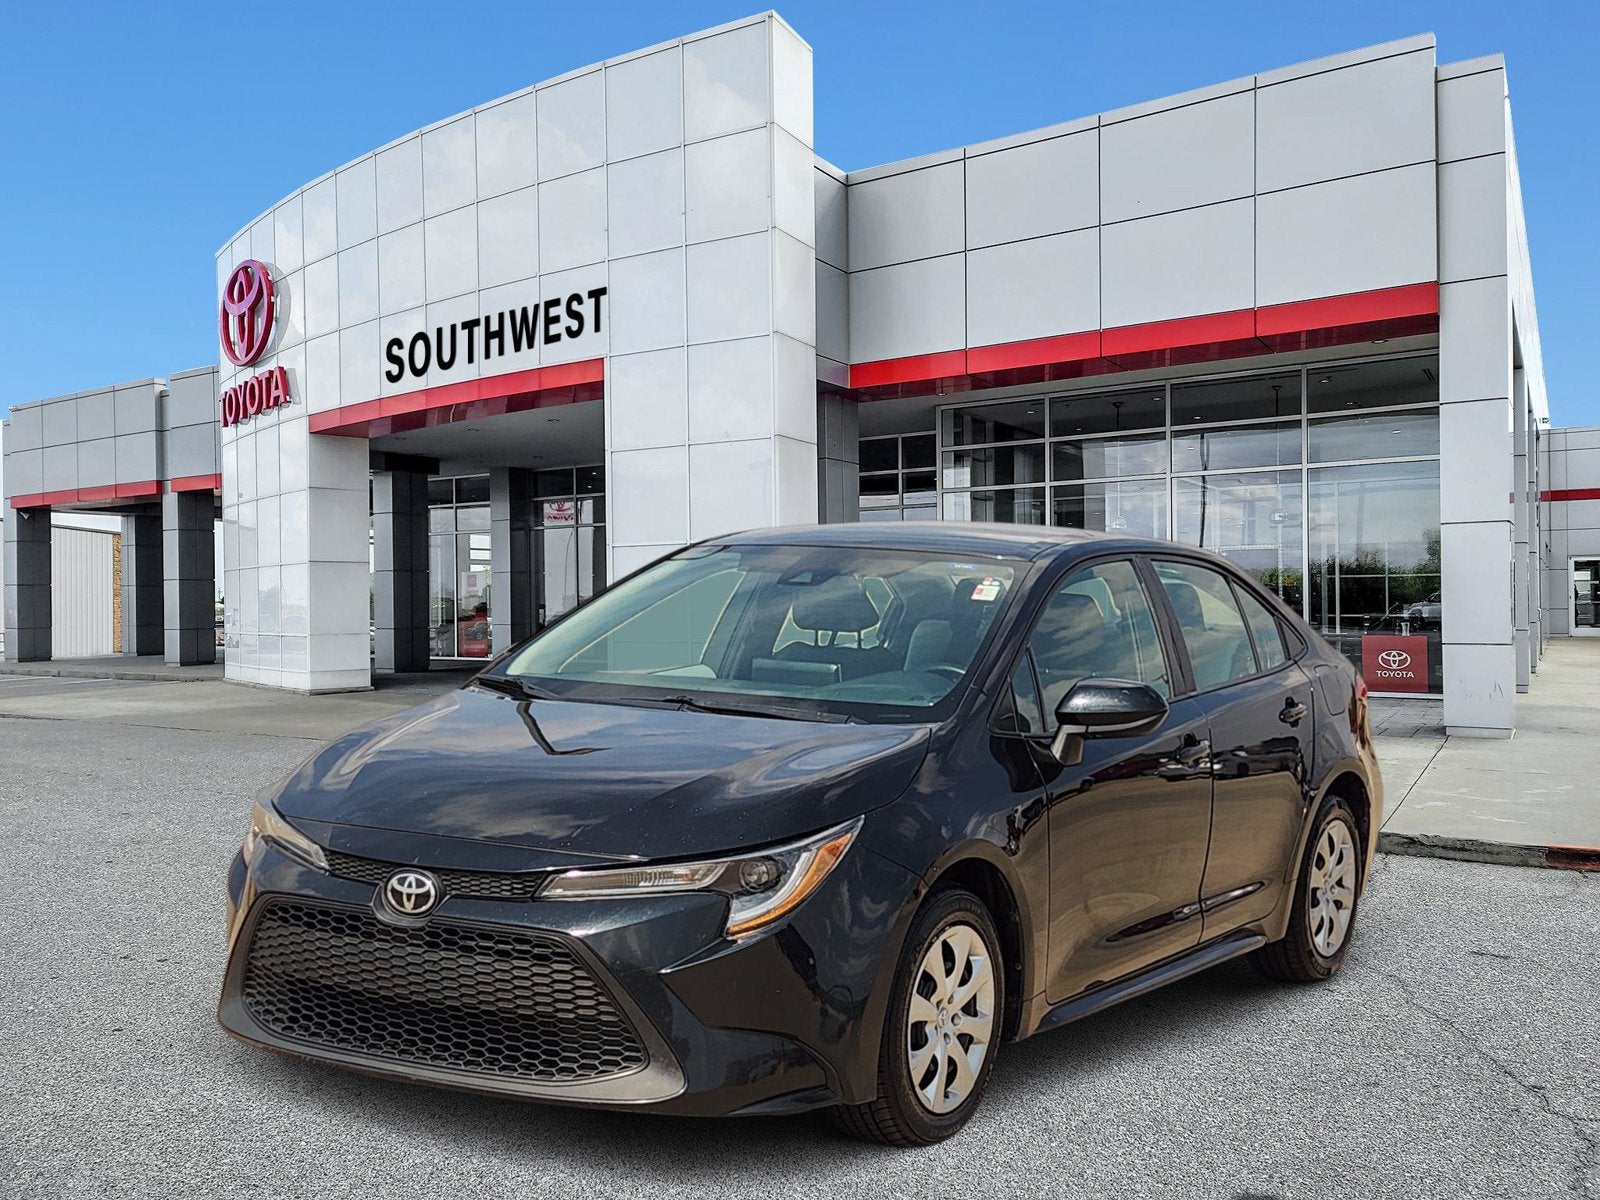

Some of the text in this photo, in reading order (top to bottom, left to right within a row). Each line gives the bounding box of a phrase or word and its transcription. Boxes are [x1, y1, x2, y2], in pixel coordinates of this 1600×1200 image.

[385, 286, 608, 384] SOUTHWEST
[218, 366, 289, 428] TOYOTA
[1375, 670, 1415, 678] TOYOTA
